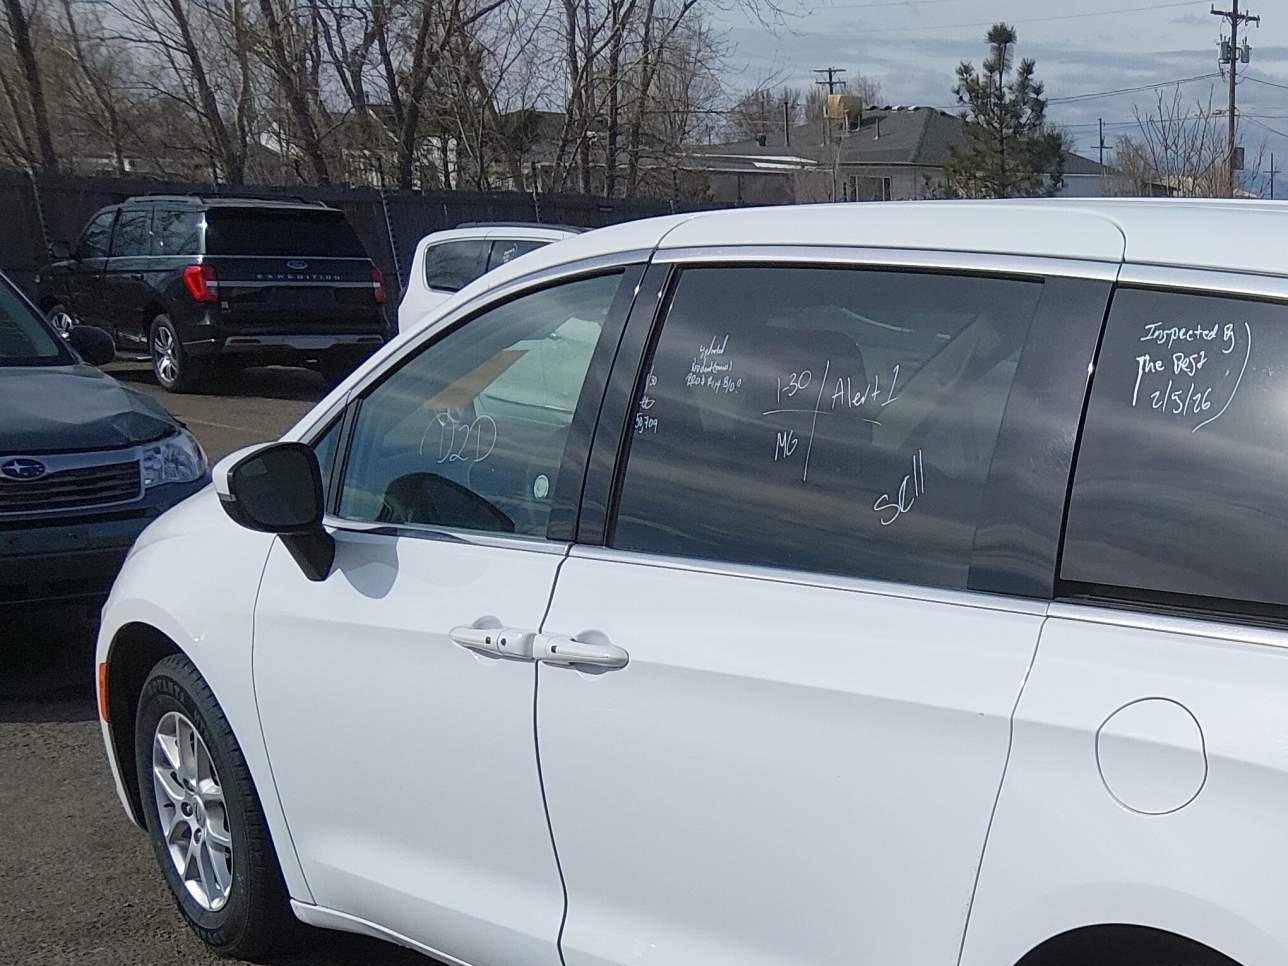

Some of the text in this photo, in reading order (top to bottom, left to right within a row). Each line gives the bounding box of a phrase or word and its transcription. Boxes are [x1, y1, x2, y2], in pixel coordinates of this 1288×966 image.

[1140, 321, 1219, 349] Inspected
[832, 375, 881, 409] Alert
[1150, 380, 1213, 416] 2/5/26
